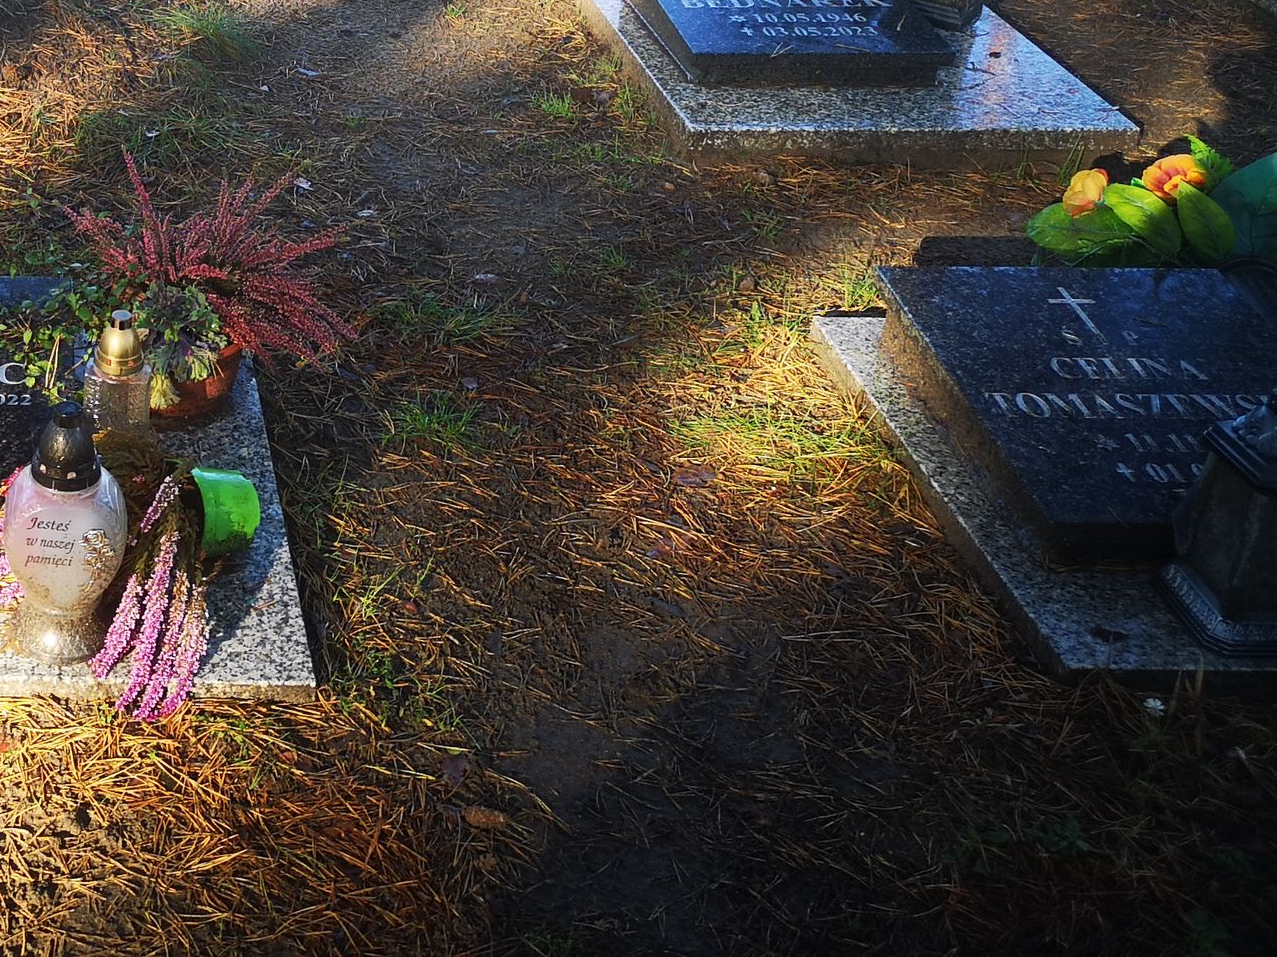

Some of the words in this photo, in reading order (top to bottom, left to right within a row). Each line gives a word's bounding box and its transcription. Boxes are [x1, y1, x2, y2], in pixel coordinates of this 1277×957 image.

[1050, 356, 1209, 380] CELINA
[26, 516, 72, 532] Jesteś
[25, 537, 38, 546] w
[39, 539, 76, 554] naszej
[24, 554, 74, 568] pamięci
